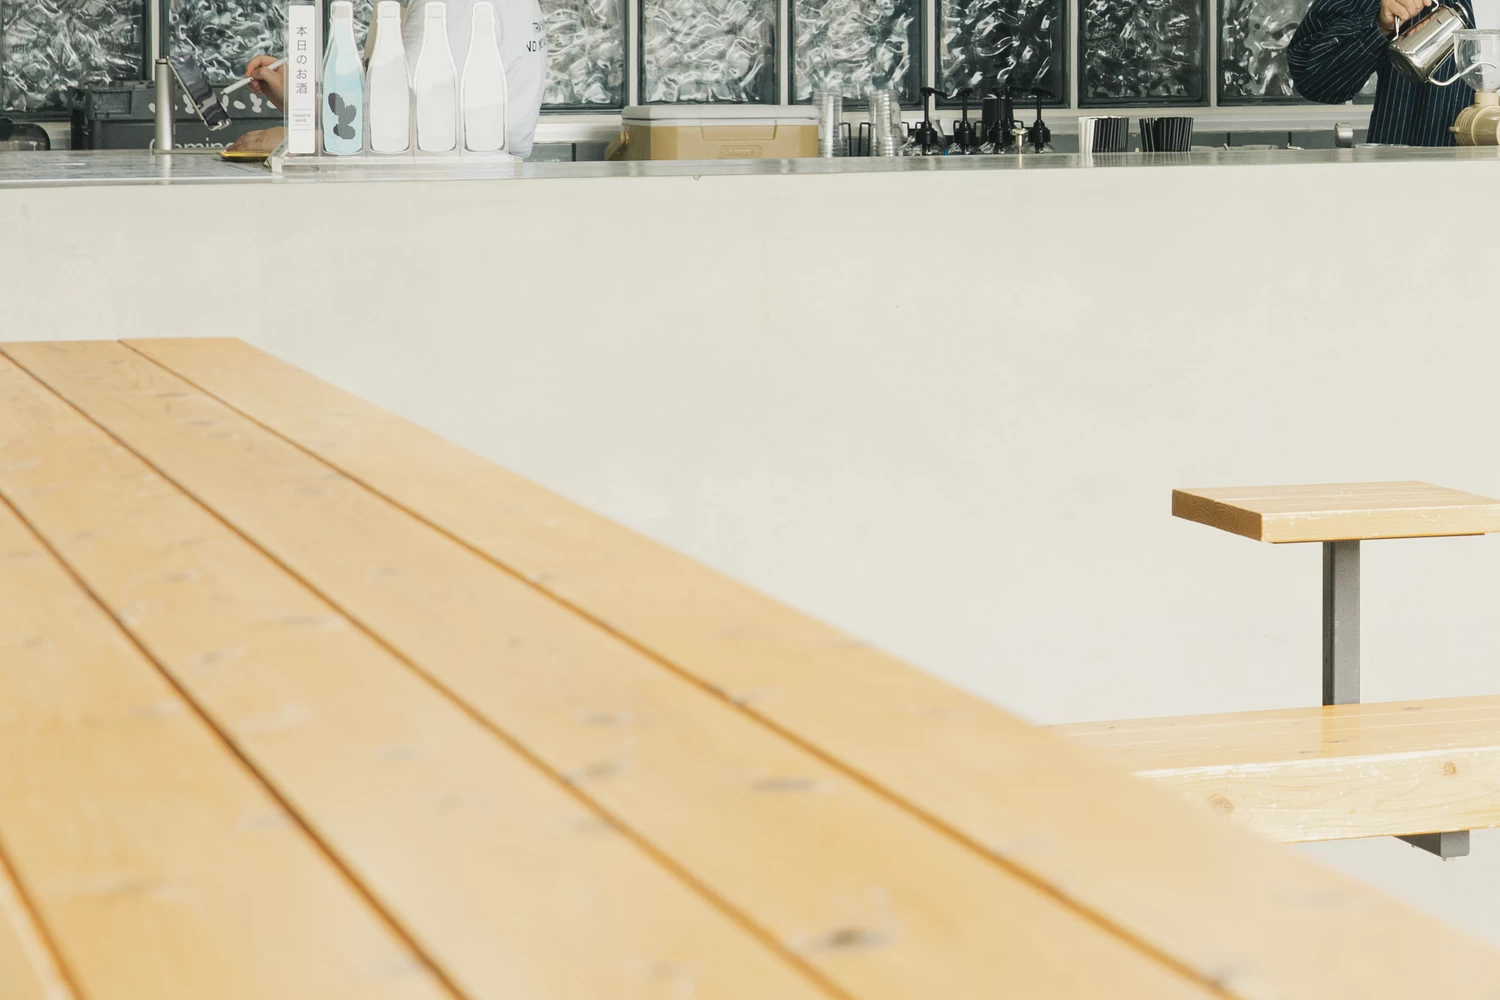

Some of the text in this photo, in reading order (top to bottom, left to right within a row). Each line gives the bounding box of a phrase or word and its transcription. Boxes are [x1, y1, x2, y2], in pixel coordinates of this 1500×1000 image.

[295, 25, 309, 95] 本日のお酒
